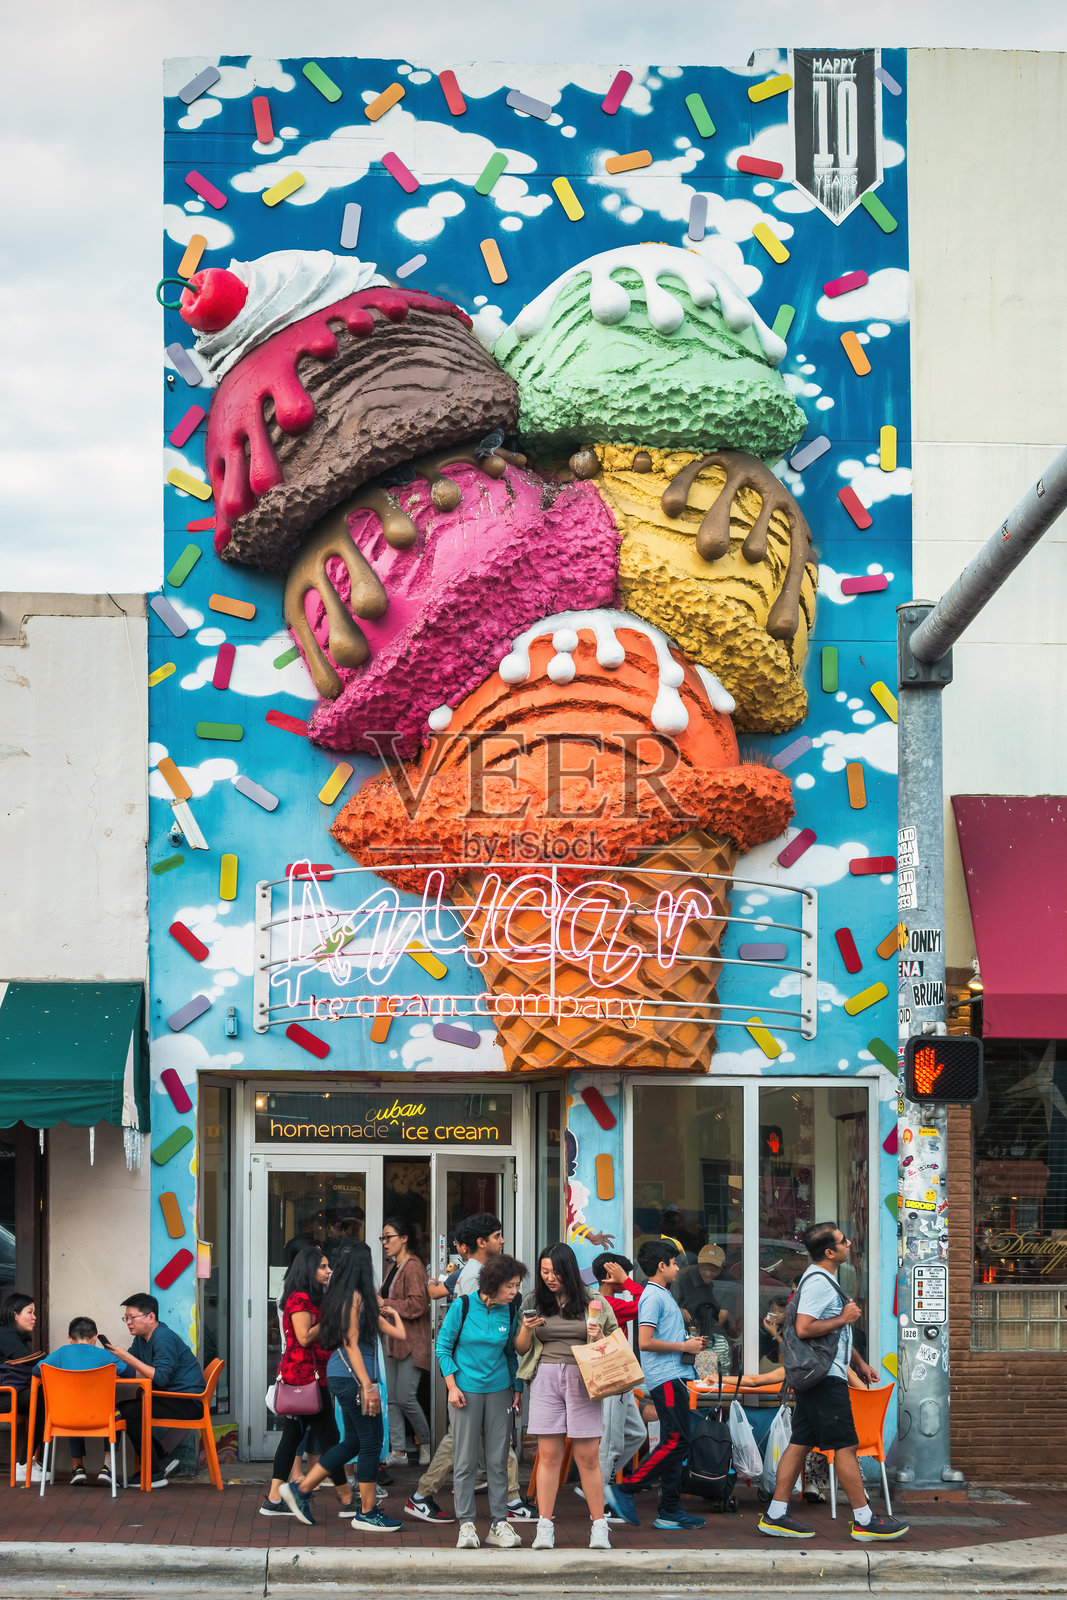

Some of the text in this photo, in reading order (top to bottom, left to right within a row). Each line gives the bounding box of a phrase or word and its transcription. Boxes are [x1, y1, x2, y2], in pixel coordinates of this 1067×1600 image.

[812, 58, 857, 72] HAPPY
[812, 80, 859, 164] 10
[815, 174, 858, 186] YEARS
[356, 993, 457, 1018] cream
[475, 992, 645, 1028] company
[365, 1099, 427, 1123] cuban
[270, 1119, 499, 1140] homemade ice cream
